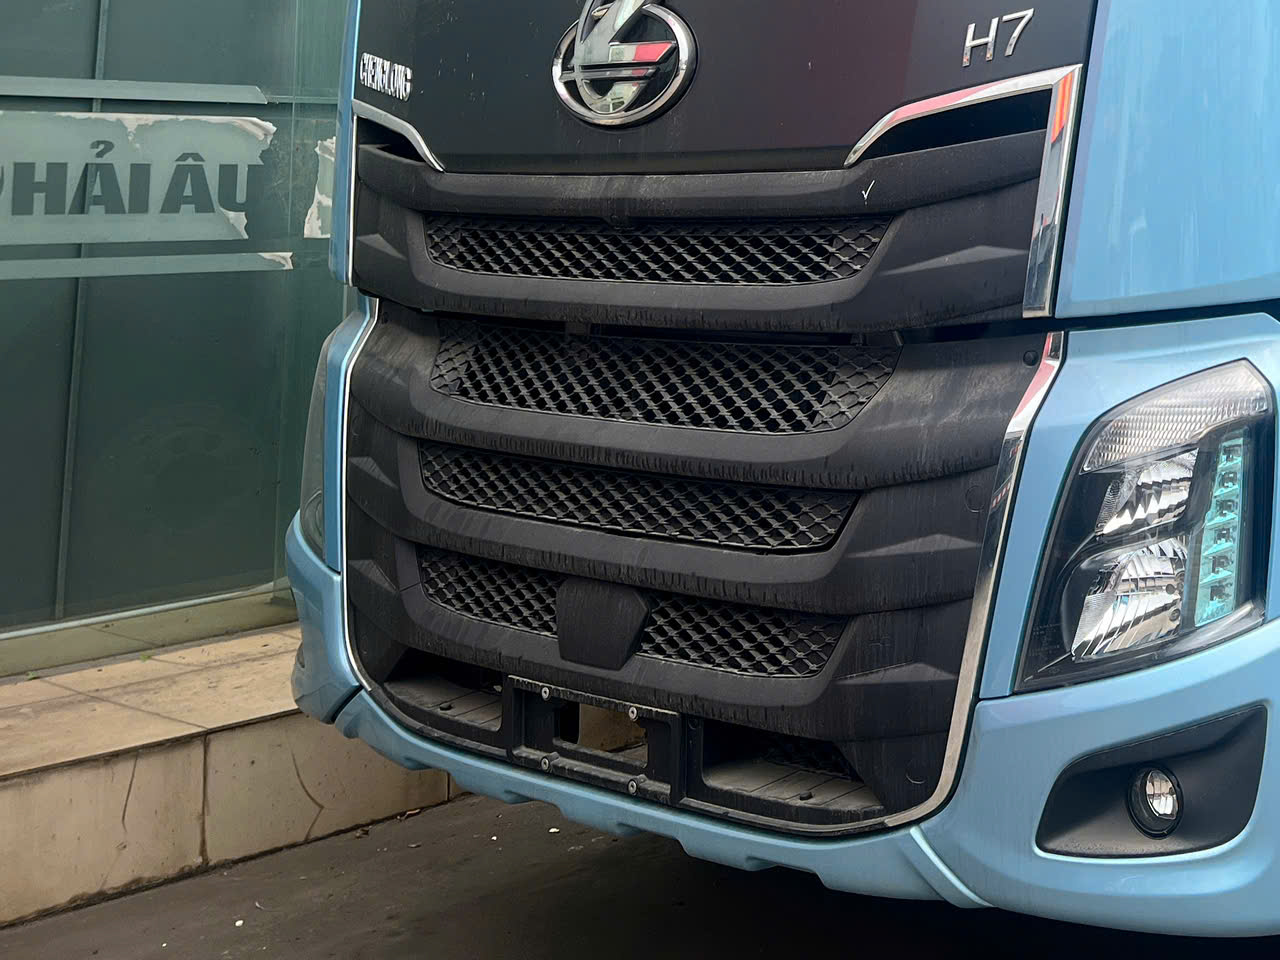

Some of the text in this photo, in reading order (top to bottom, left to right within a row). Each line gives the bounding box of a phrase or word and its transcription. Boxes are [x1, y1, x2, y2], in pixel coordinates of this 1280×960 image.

[962, 8, 1035, 67] H7
[11, 140, 151, 216] HẢI
[159, 152, 264, 214] ÂU
